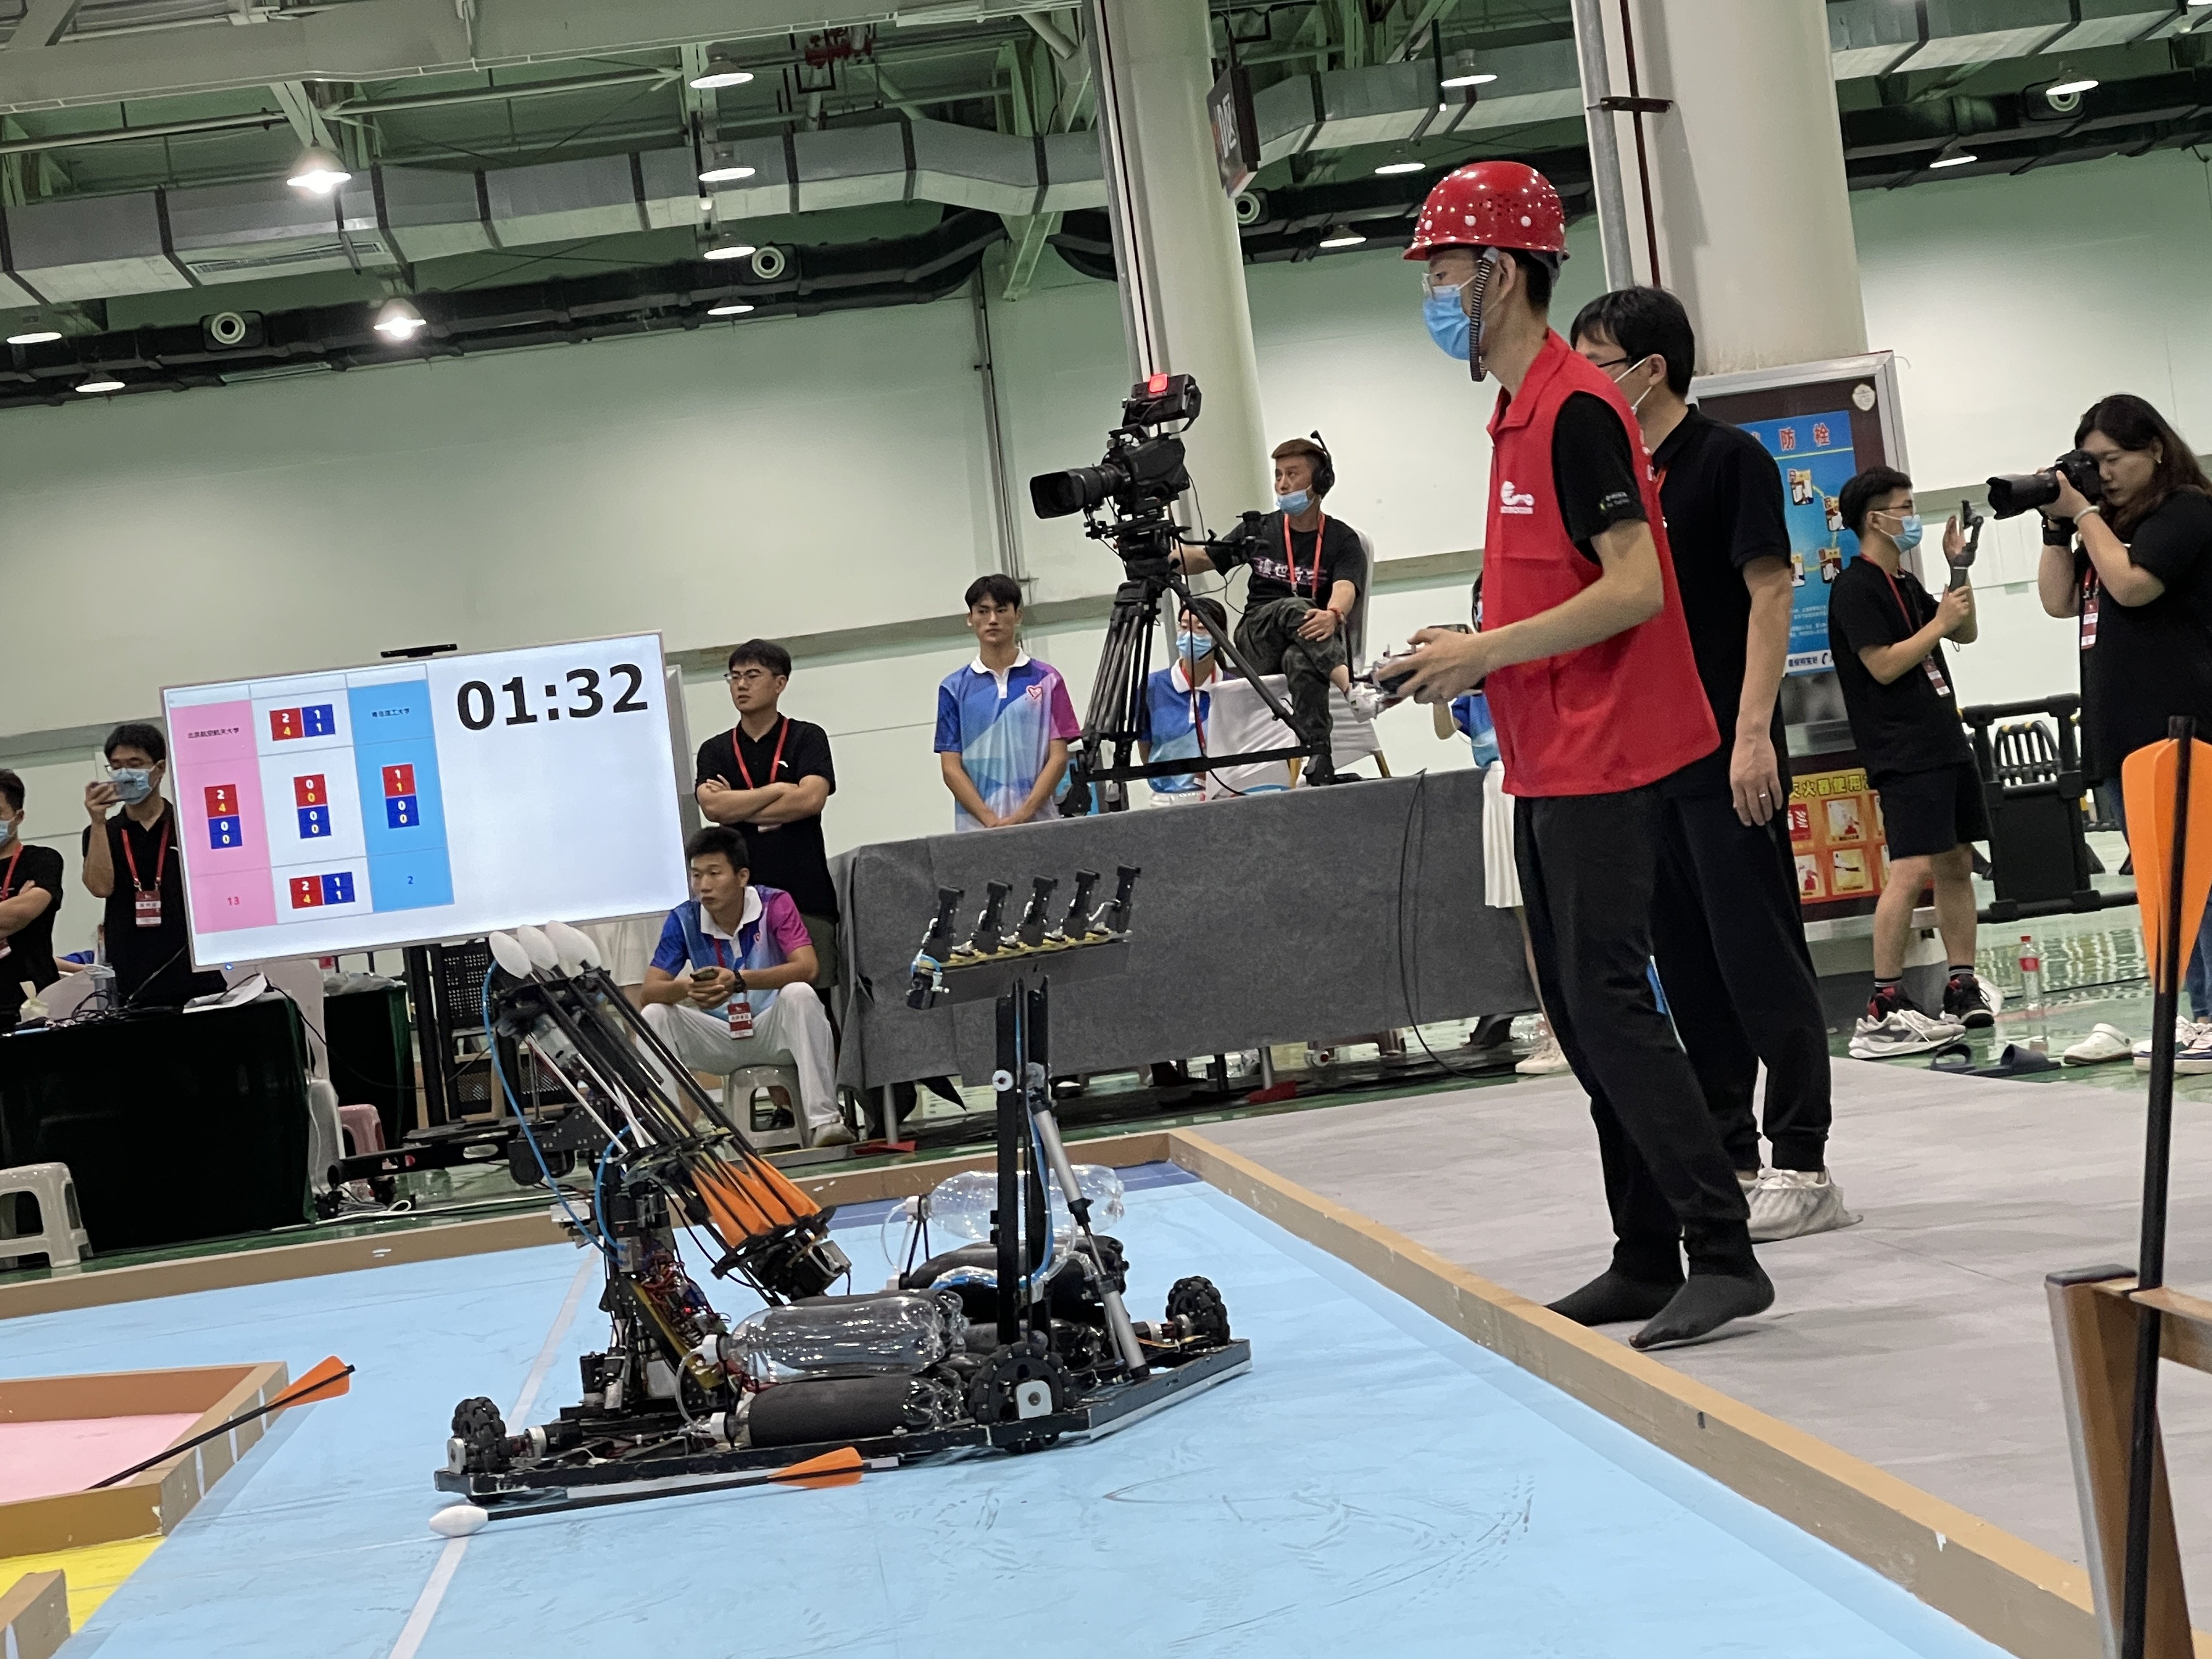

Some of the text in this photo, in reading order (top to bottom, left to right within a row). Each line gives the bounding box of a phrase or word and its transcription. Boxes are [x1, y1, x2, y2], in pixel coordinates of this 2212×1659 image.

[457, 663, 648, 731] 01:32
[281, 713, 290, 724] 2
[314, 709, 321, 719] 1
[283, 726, 291, 736] 4
[315, 722, 323, 733] 1
[394, 769, 401, 779] 1
[306, 778, 315, 789] 0
[396, 782, 403, 792] 1
[1788, 774, 1870, 799] 灭火器使用
[217, 789, 225, 800] 2
[307, 792, 316, 803] 0
[397, 800, 407, 811] 0
[309, 810, 318, 821] 0
[399, 814, 408, 824] 0
[220, 821, 229, 832] 0
[311, 823, 320, 834] 0
[222, 834, 231, 845] 0
[301, 881, 309, 891] 2
[334, 877, 341, 887] 1
[407, 876, 414, 885] 2
[303, 894, 311, 904] 4
[335, 890, 342, 900] 1
[228, 896, 240, 906] 13
